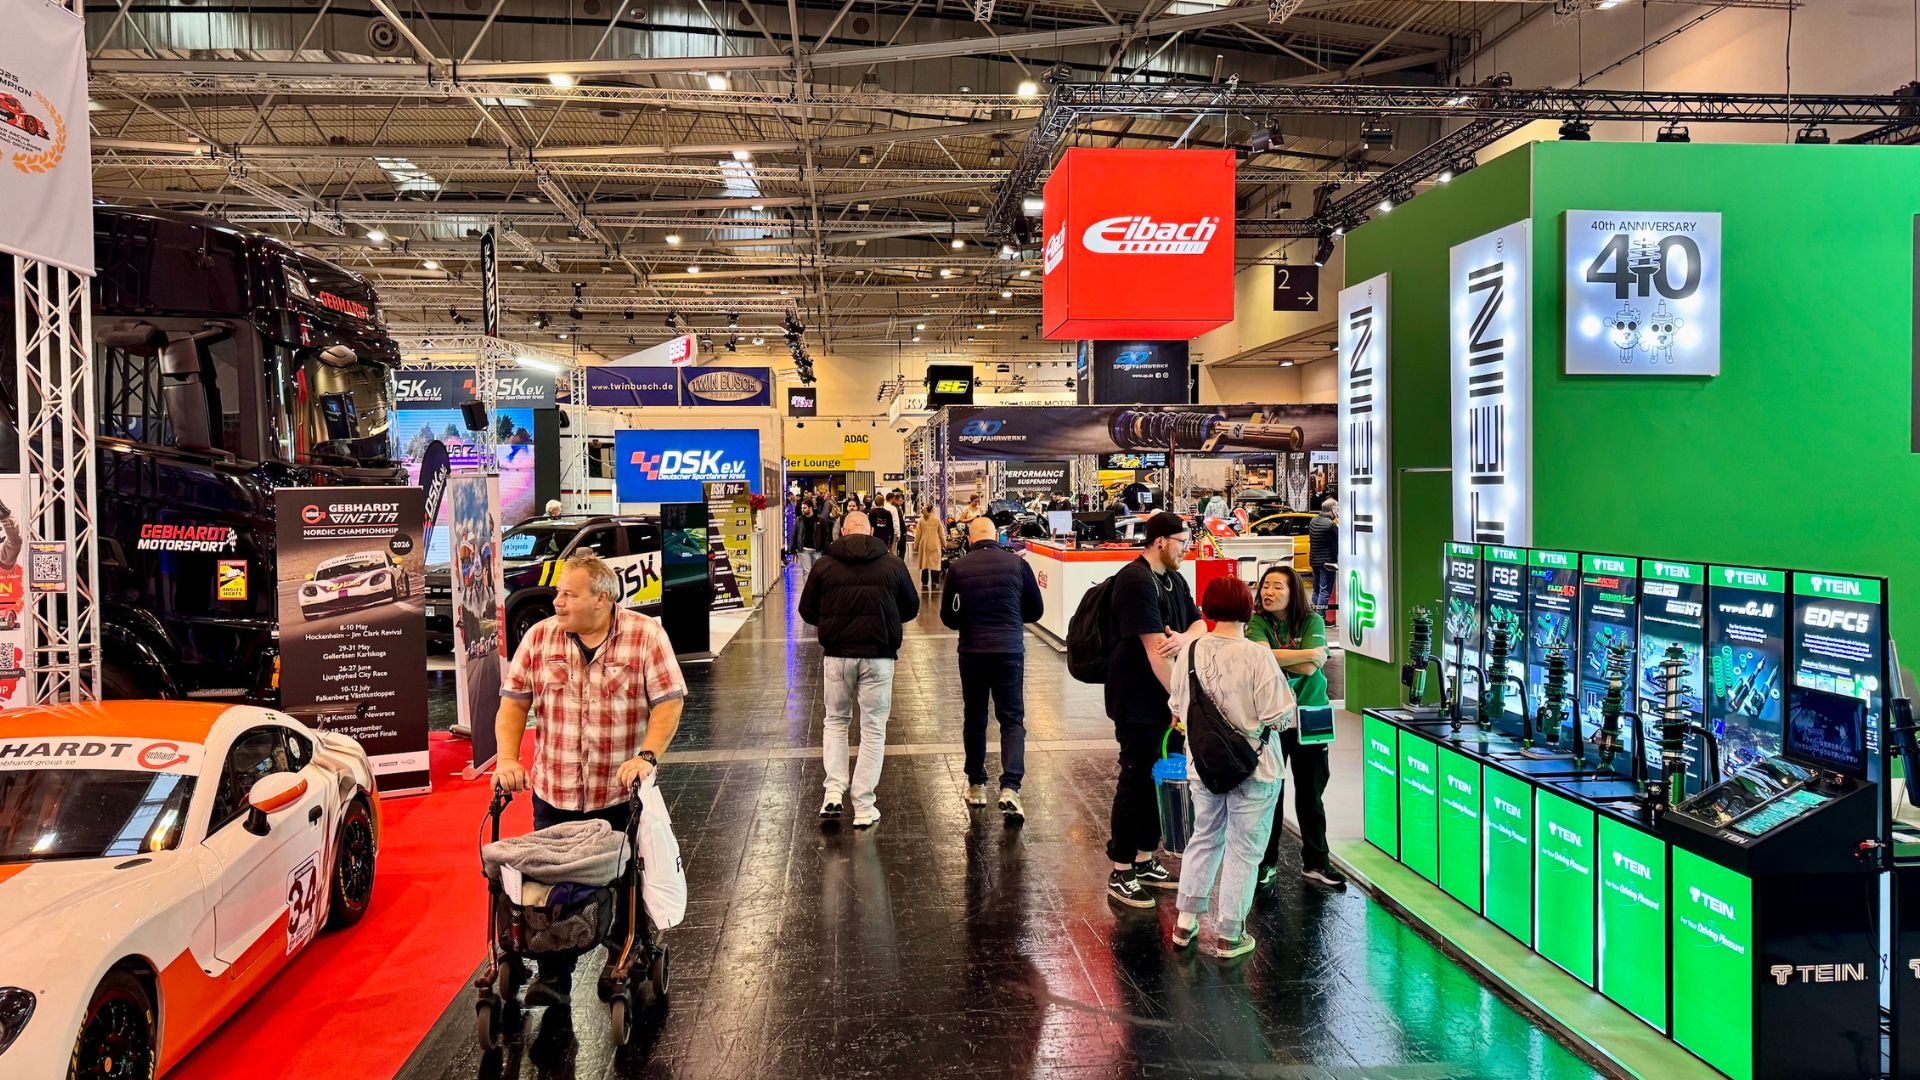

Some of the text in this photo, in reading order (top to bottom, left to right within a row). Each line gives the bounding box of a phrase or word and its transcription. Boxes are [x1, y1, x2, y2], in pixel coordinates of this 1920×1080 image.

[1591, 221, 1697, 231] 40th ANNIVERSARY
[1082, 216, 1217, 254] Eibach
[1278, 269, 1291, 289] 2
[320, 291, 369, 320] GEBHARDT
[592, 382, 673, 391] www.twinbusch.de
[720, 373, 757, 391] BUSCH
[526, 386, 545, 395] e.V.
[1350, 306, 1373, 555] TEIN
[844, 435, 869, 443] ADAC
[660, 450, 746, 474] DSK e.V.
[804, 459, 840, 468] Lounge
[1004, 470, 1065, 478] PERFORMANCE
[329, 503, 399, 512] GEBHARDT
[329, 513, 399, 523] GINETTA
[141, 524, 229, 541] GEBHARDT
[303, 527, 399, 536] NORDIC CHAMPIONSHIP
[137, 539, 226, 552] MOTORSPORT
[1451, 562, 1475, 579] FS2
[1492, 567, 1518, 586] FS2
[1803, 607, 1870, 633] EDFC5
[305, 632, 344, 640] Hockenheim
[316, 694, 349, 702] Falkenberg
[317, 714, 331, 722] Rng
[350, 725, 382, 734] September
[288, 866, 317, 934] 34
[1697, 922, 1718, 943] Driving
